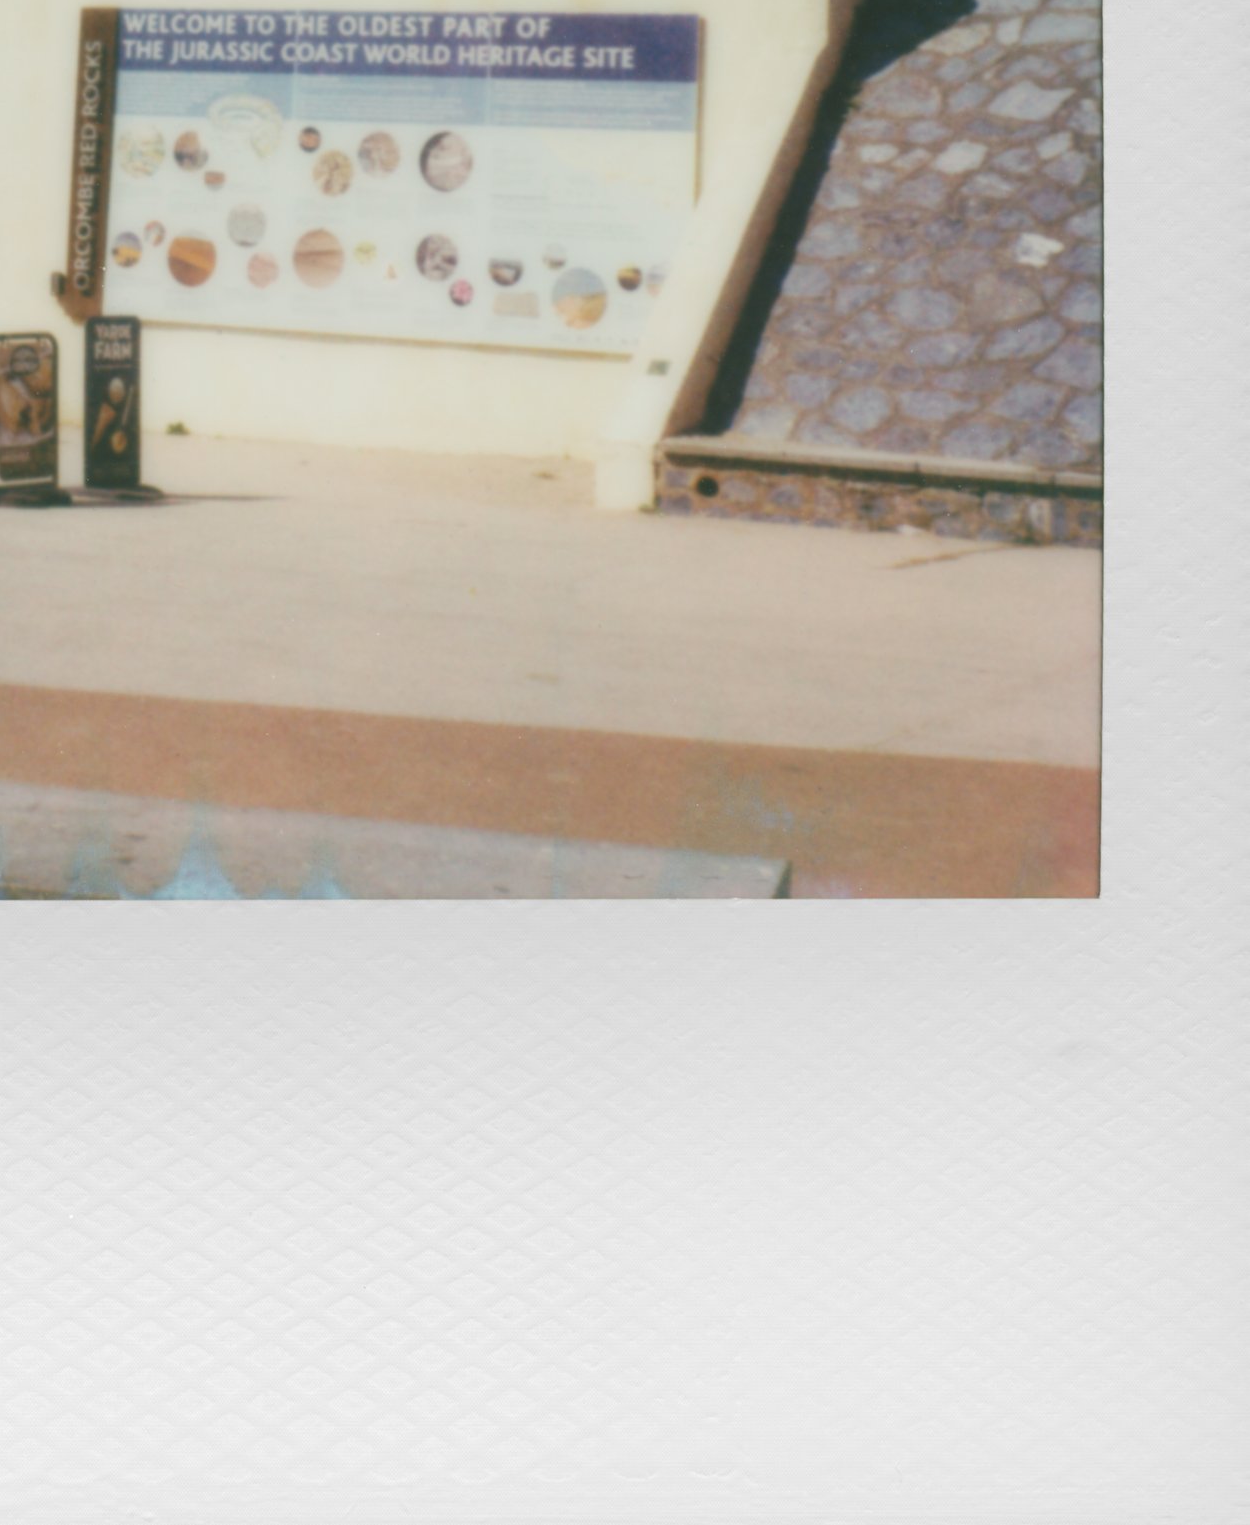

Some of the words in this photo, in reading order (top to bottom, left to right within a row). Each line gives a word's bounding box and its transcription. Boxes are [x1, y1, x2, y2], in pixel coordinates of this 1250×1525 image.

[124, 13, 237, 35] WELCOME
[244, 14, 275, 35] TO
[283, 15, 329, 36] THE
[338, 15, 434, 38] OLDEST
[443, 17, 507, 38] PART
[516, 17, 552, 39] OF
[123, 39, 164, 61] THE
[168, 40, 274, 64] JURASSIC
[281, 42, 358, 64] COAST
[364, 44, 450, 65] WORLD
[458, 45, 575, 67] HERITAGE
[584, 47, 636, 69] SITE
[83, 40, 102, 116] ROCKS
[80, 123, 97, 167] RED
[73, 174, 95, 291] ORCOMBE
[94, 341, 132, 360] FARM
